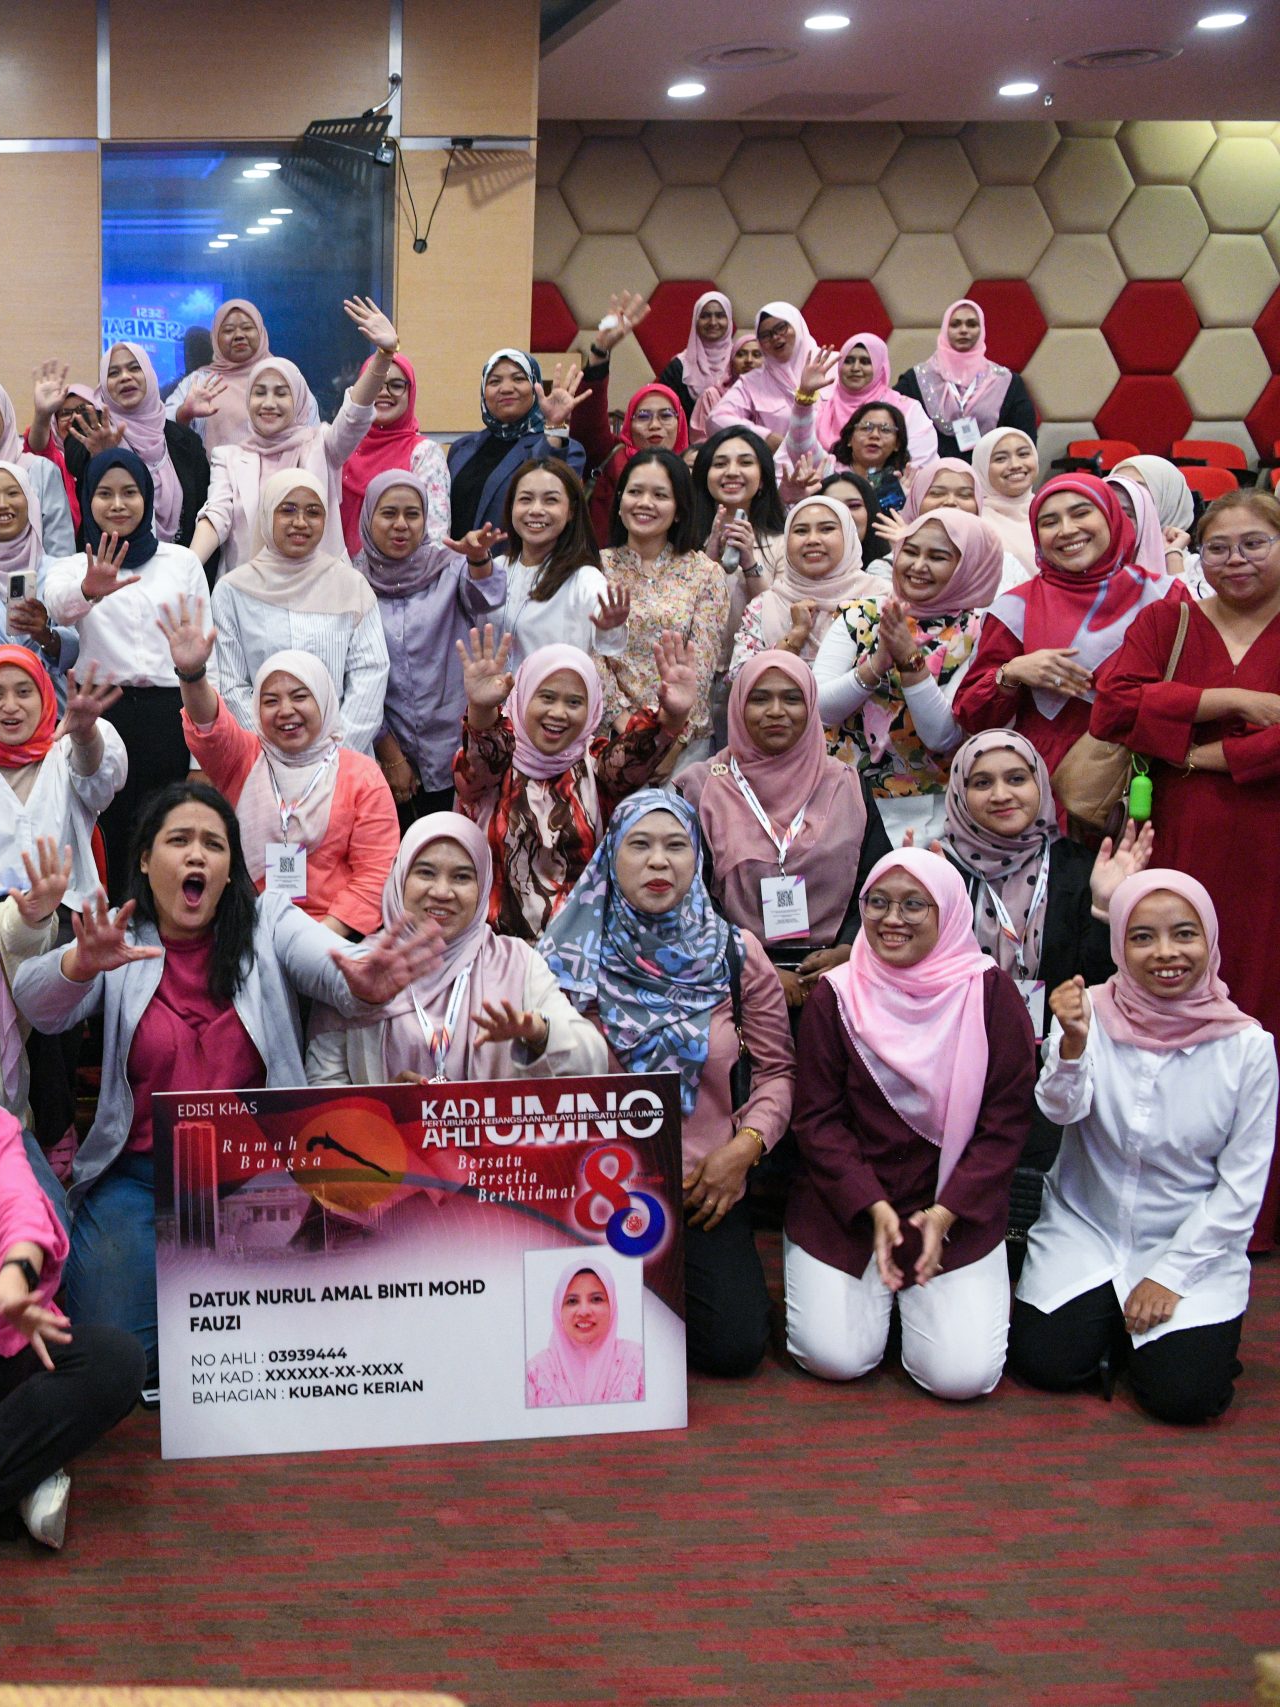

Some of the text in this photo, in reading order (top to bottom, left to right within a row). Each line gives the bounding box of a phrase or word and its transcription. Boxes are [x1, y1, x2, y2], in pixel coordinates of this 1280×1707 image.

[177, 1101, 258, 1118] EDISI KHAS
[421, 1089, 664, 1146] KAD UMNO
[421, 1109, 664, 1128] PERTUBUHAN KEBANGSAAN MELAYU BERSATU ATAU UMNO
[222, 1135, 298, 1154] Rumah
[421, 1127, 481, 1149] AHLI
[239, 1154, 322, 1173] Bangsa
[457, 1152, 523, 1171] Bersatu
[467, 1169, 538, 1187] Bersetia
[477, 1184, 577, 1204] Berkhidmat
[188, 1278, 487, 1309] DATUK NURUL AMAL BINTI MOHD
[189, 1314, 242, 1333] FAUZI
[191, 1353, 217, 1367] NO
[220, 1350, 257, 1366] AHLI
[268, 1346, 348, 1363] 03939444
[191, 1371, 217, 1385] MY
[220, 1369, 255, 1384] KAD
[264, 1361, 405, 1382] XXXXXX-XX-XXXX
[192, 1387, 278, 1405] BAHAGIAN
[288, 1382, 360, 1400] KUBANG
[363, 1379, 425, 1395] KERIAN
